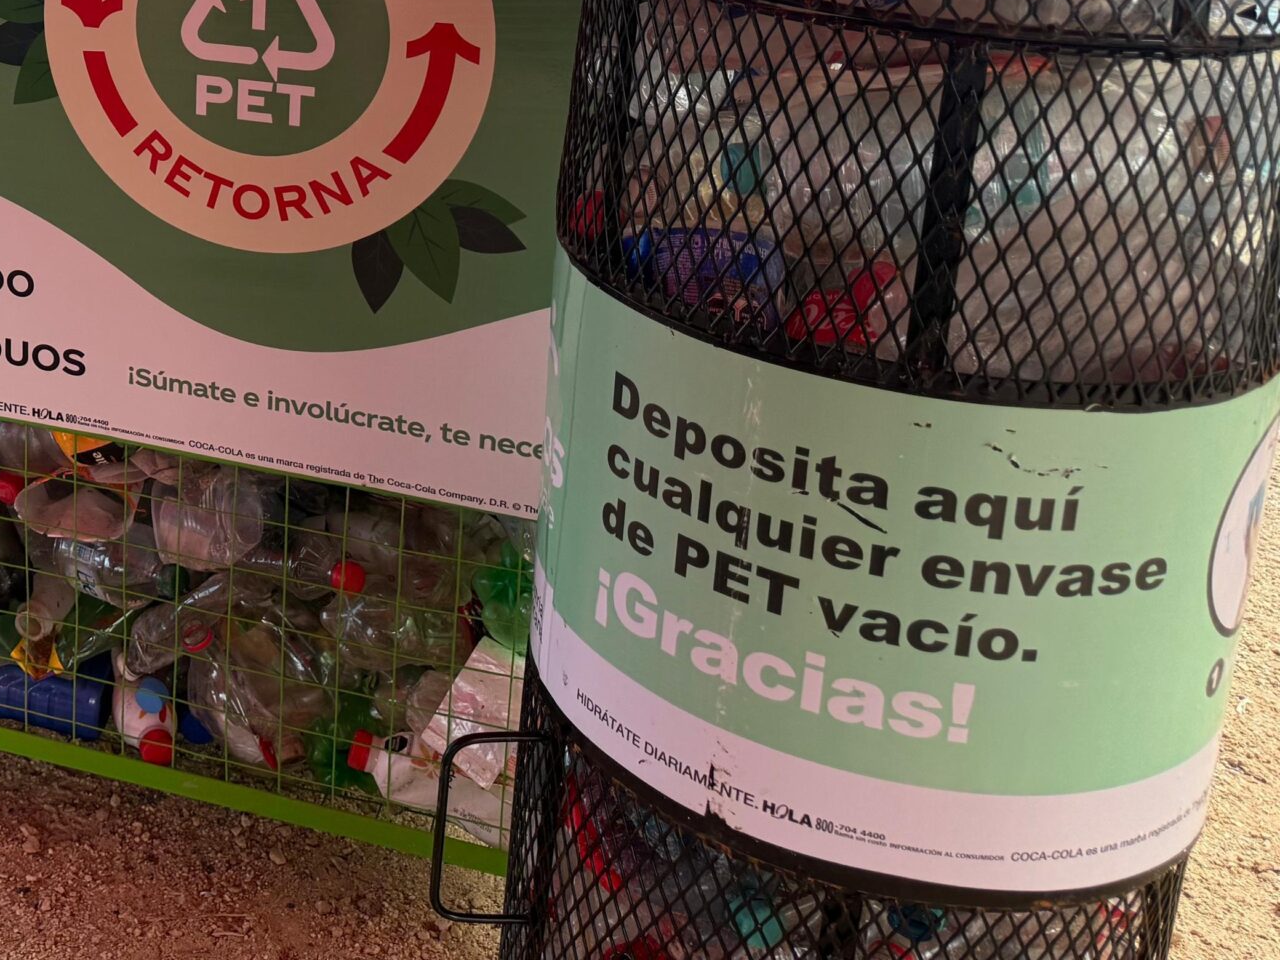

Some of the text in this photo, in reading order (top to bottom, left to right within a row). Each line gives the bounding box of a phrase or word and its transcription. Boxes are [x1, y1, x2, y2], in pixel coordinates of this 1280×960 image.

[195, 74, 316, 128] PET
[132, 129, 392, 222] RETORNA
[128, 365, 236, 404] ¡Súmate
[243, 390, 260, 408] e
[267, 390, 432, 443] involúcrate,
[440, 422, 471, 447] te
[612, 370, 889, 512] Deposita
[914, 485, 1084, 540] aquí
[188, 440, 243, 458] COCA-COLA
[258, 454, 275, 464] una
[276, 457, 304, 470] marca
[306, 462, 351, 479] registrada
[353, 470, 366, 481] de
[368, 473, 385, 485] The
[387, 477, 437, 495] Coca-Cola
[438, 487, 487, 507] Company.
[607, 443, 900, 578] cualquier
[921, 556, 1168, 598] envase
[602, 498, 655, 557] de
[674, 534, 800, 616] PET
[817, 596, 1038, 663] vacío.
[594, 567, 976, 744] ¡Gracias!
[576, 688, 641, 749] HIDRÁTATE
[644, 740, 759, 810] DIARIAMENTE.
[1010, 848, 1083, 863] COCA-COLA
